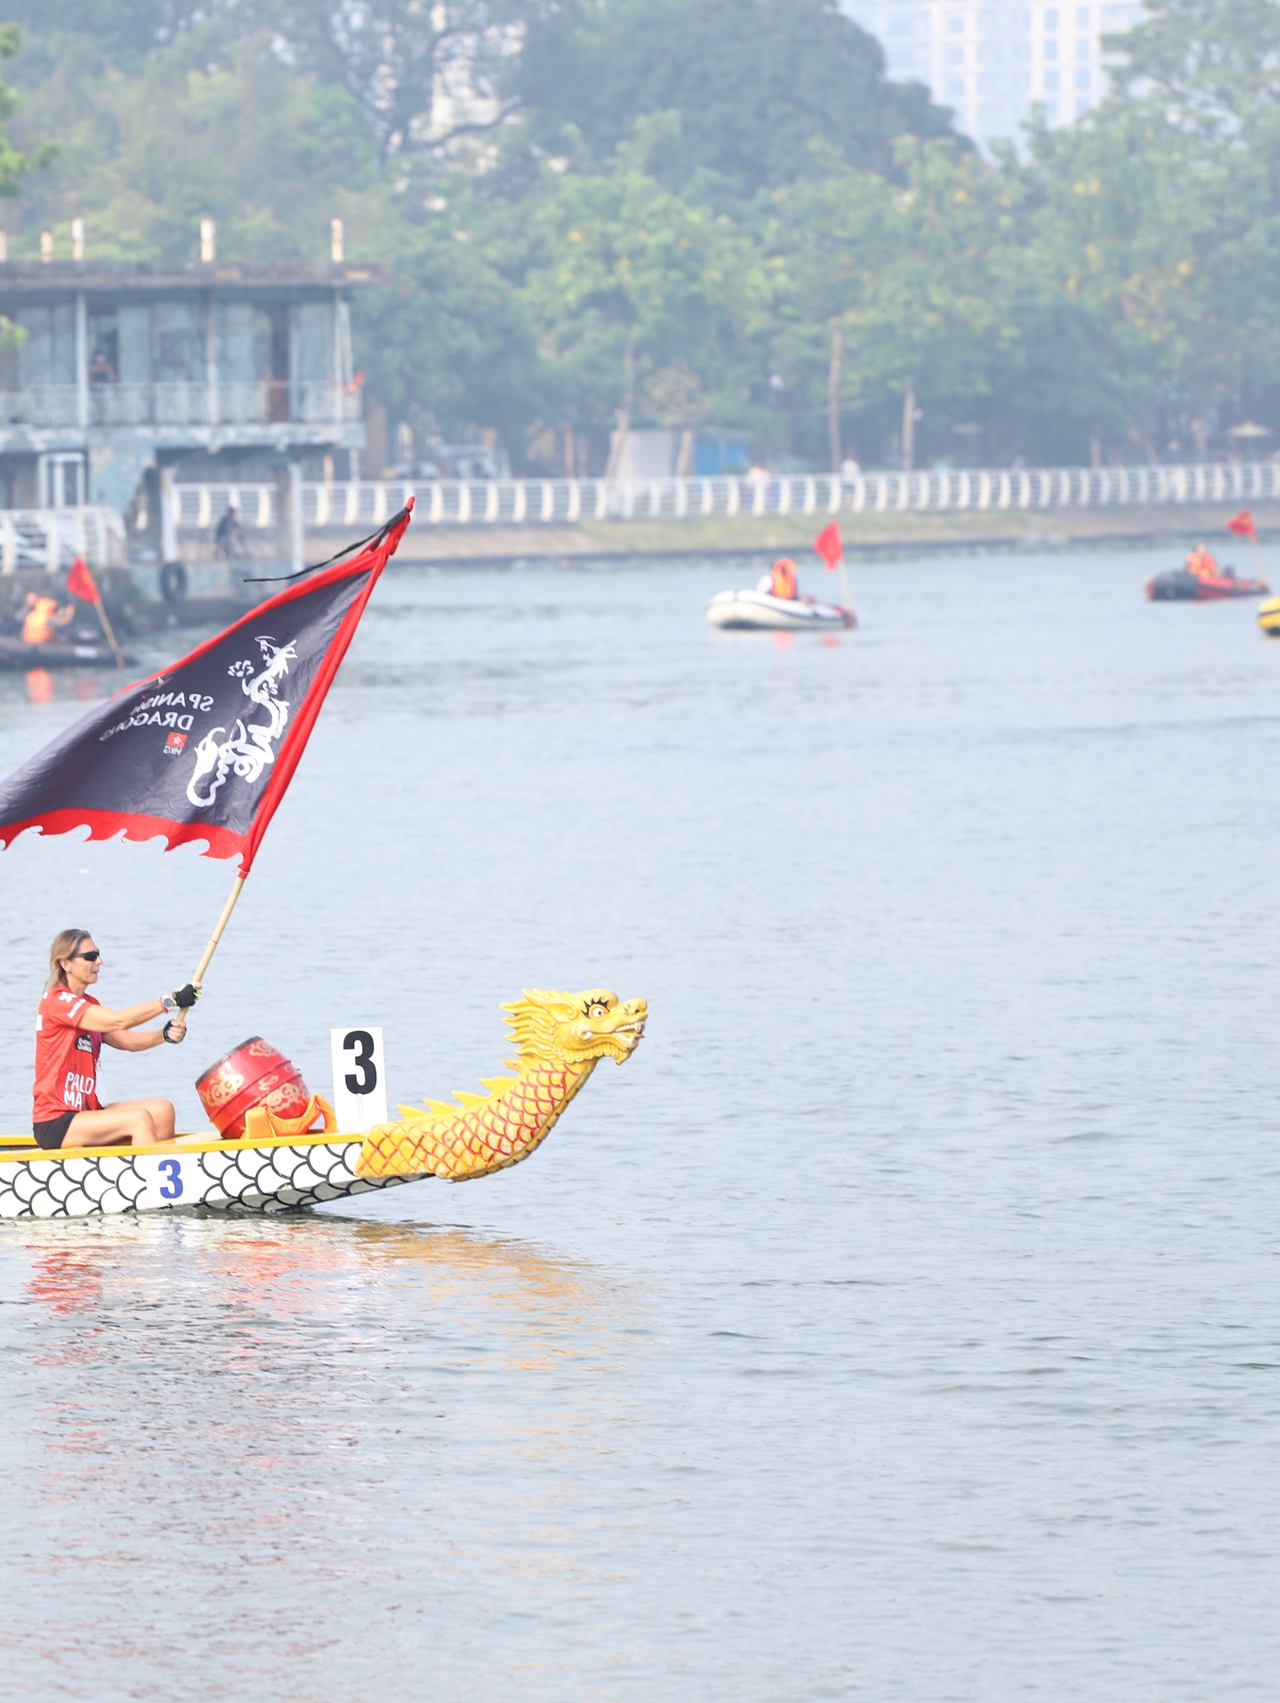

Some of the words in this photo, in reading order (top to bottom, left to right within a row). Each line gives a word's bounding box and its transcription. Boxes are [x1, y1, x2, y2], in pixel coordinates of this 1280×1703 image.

[342, 1030, 377, 1095] 3
[65, 1071, 94, 1095] PALO
[63, 1090, 83, 1110] MA
[157, 1159, 183, 1199] 3
